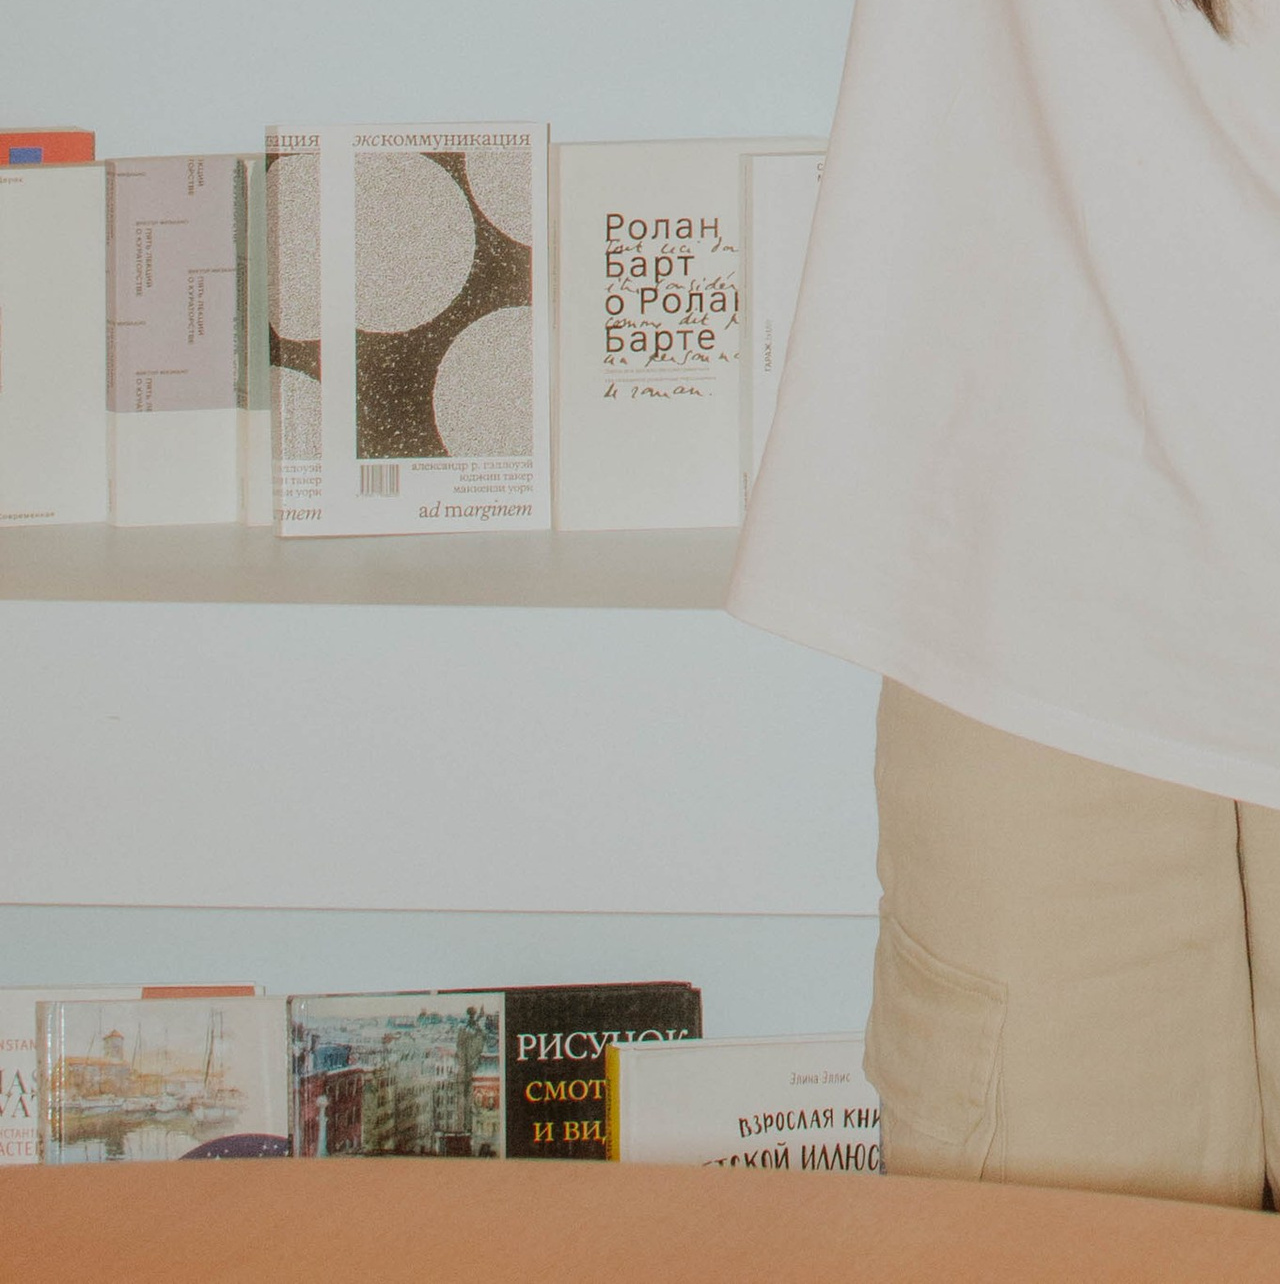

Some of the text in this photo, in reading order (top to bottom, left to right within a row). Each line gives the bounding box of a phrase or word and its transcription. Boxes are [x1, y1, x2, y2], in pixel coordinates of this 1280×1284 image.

[352, 132, 532, 150] экскоммуникация
[605, 212, 719, 242] Ролан
[605, 251, 695, 284] Барт
[605, 293, 625, 316] о
[605, 323, 716, 358] Барте
[504, 471, 534, 482] такер
[418, 499, 533, 522] ad marginem
[789, 1070, 852, 1086] Элина Эллис
[532, 1121, 554, 1143] И
[738, 1106, 834, 1139] ВЗРОСЛАЯ
